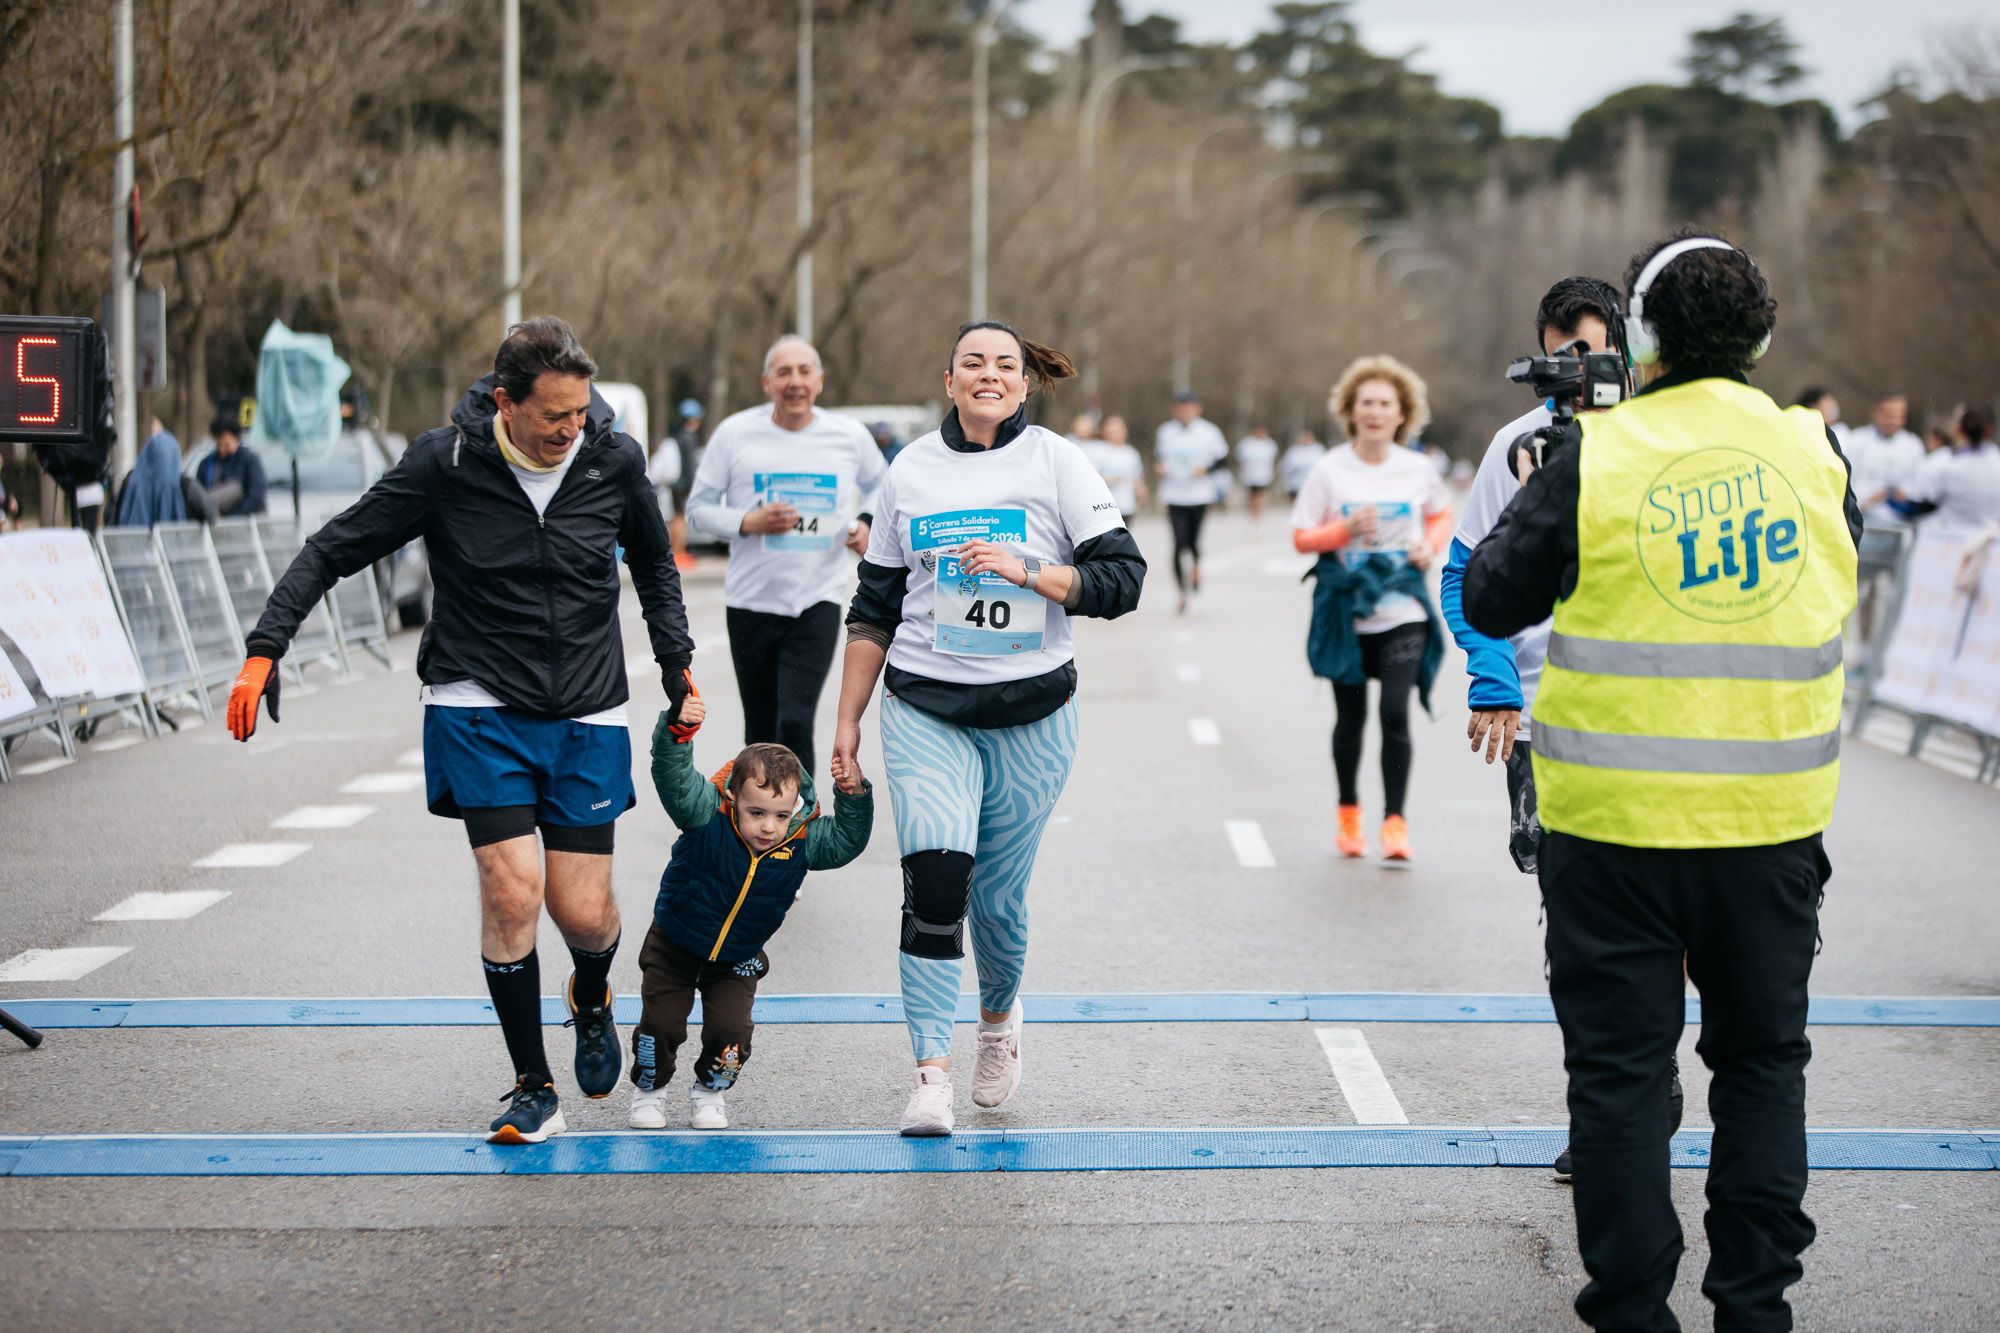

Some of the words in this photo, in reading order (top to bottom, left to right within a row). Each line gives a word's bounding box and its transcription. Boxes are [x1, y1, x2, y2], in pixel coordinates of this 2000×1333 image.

[18, 337, 60, 423] 5
[1649, 464, 1770, 534] Sport
[929, 519, 960, 530] Carrera
[961, 516, 1000, 526] Solidaria
[990, 532, 1021, 543] 2026
[1677, 508, 1799, 591] Life
[965, 599, 1010, 629] 40
[637, 1033, 656, 1067] BINGO
